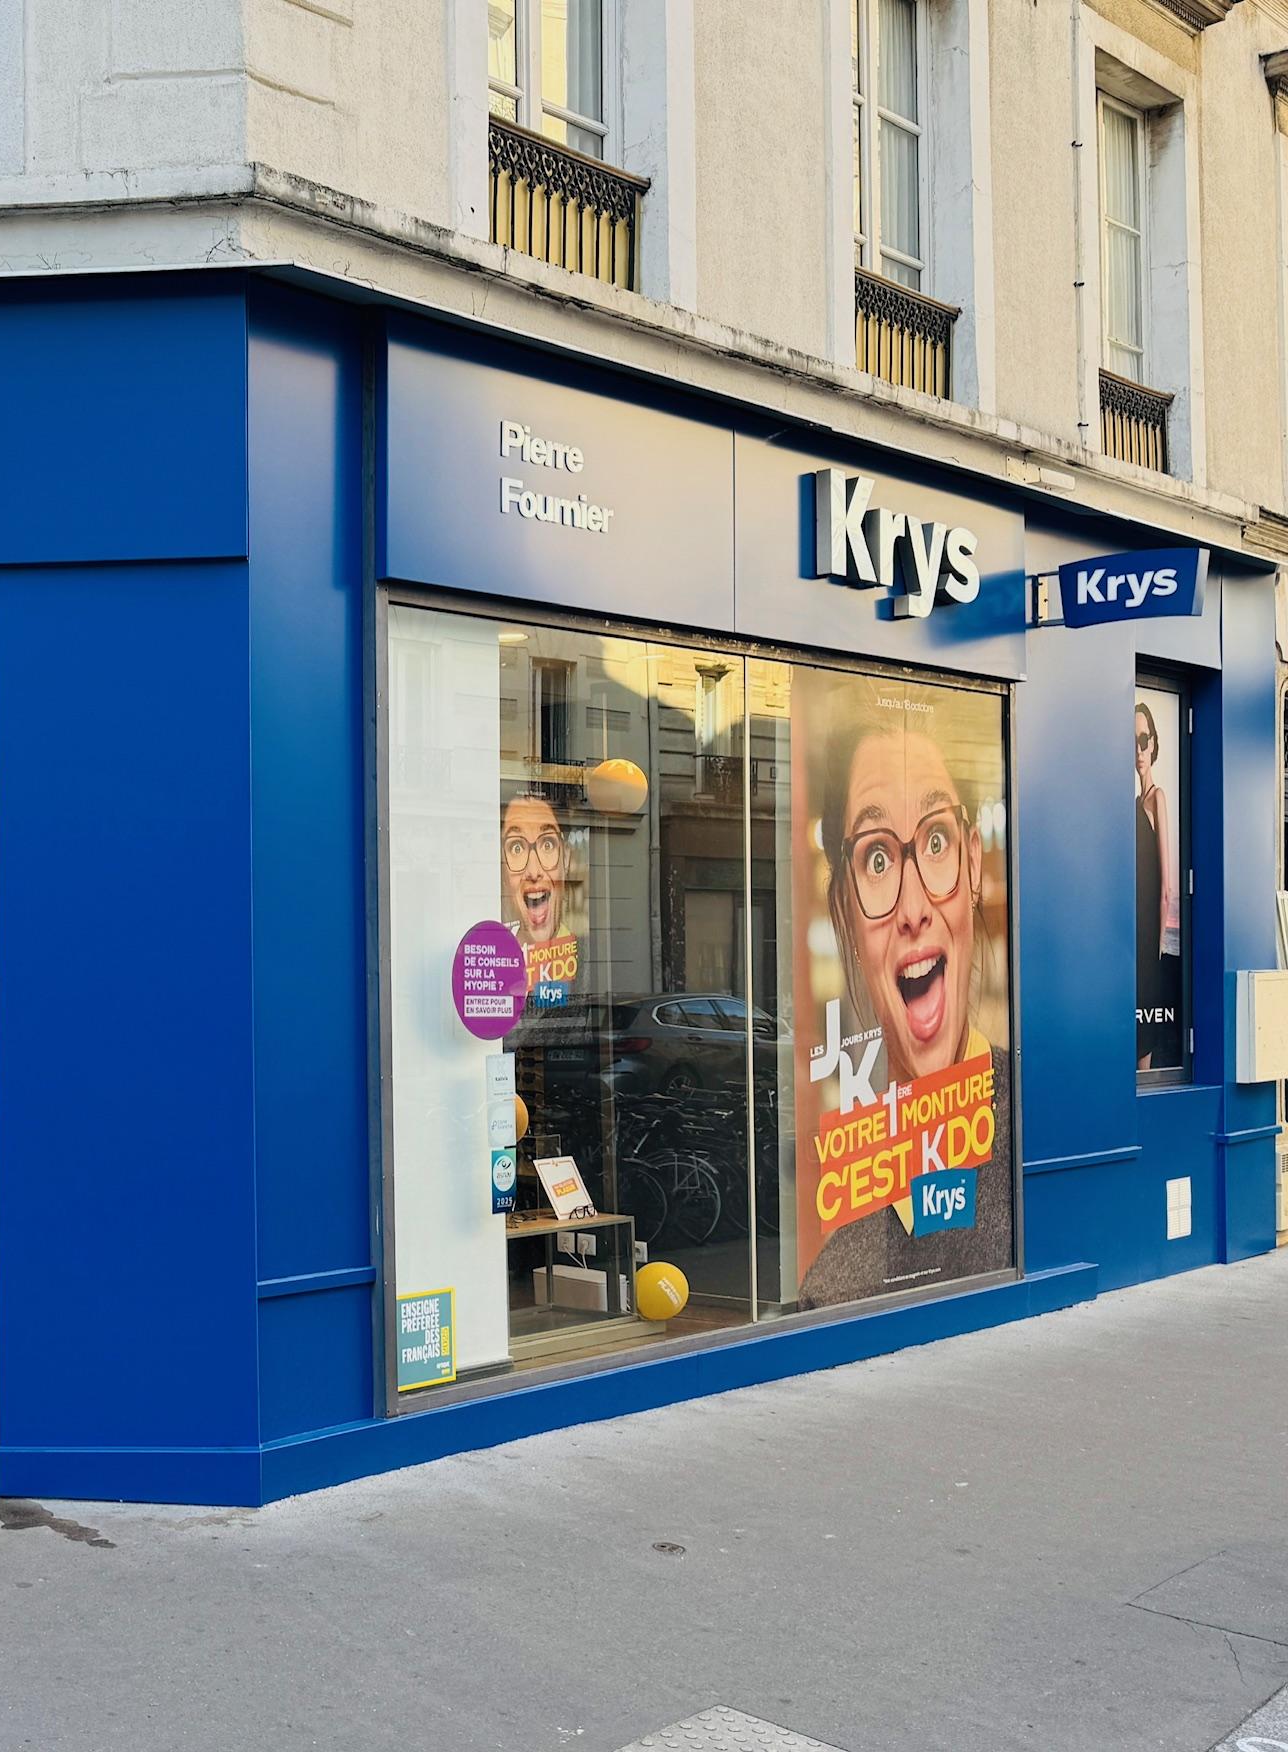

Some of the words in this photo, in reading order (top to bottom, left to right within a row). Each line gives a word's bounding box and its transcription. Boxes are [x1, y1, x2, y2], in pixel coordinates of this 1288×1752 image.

[501, 420, 585, 473] Pierre
[501, 476, 614, 533] Fournier
[817, 468, 981, 618] Krys
[1076, 567, 1179, 608] Krys
[464, 944, 496, 955] BESOIN
[529, 941, 577, 963] MONTURE
[464, 956, 476, 967] DE
[478, 957, 519, 968] CONSEILS
[464, 969, 482, 979] SUR
[484, 969, 495, 979] LA
[464, 980, 497, 991] MYOPIE
[499, 980, 504, 991] ?
[540, 985, 563, 1002] Krys
[466, 998, 489, 1006] ENTREZ
[490, 998, 506, 1006] POUR
[466, 1006, 474, 1014] EN
[475, 1006, 496, 1014] SAVOIR
[497, 1006, 512, 1014] PLUS
[841, 1031, 863, 1049] JOURS
[864, 1027, 883, 1042] KRYS
[810, 1044, 824, 1058] LES
[814, 1110, 887, 1164] VOTRE
[901, 1068, 996, 1132] MONTURE
[816, 1138, 914, 1222] C'EST
[922, 1183, 967, 1221] Krys
[401, 1298, 440, 1319] ENSEIGNE
[425, 1328, 441, 1345] DES
[402, 1342, 441, 1364] FRANÇAIS
